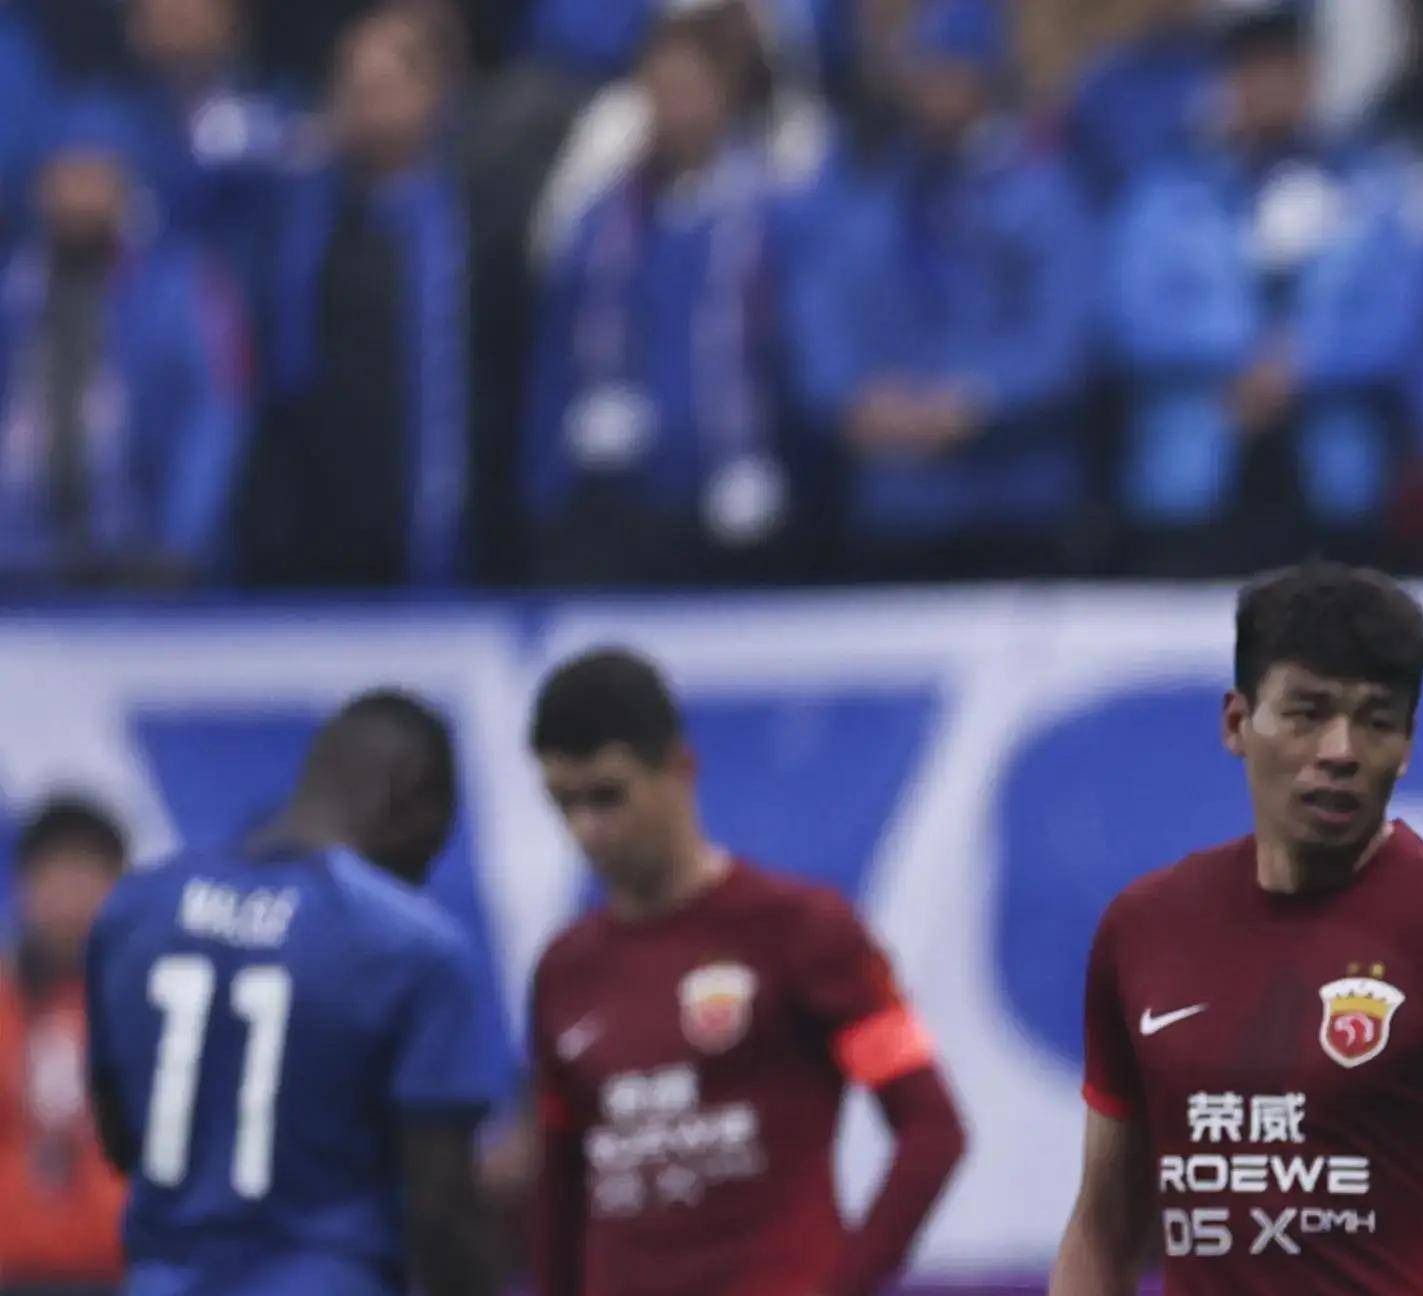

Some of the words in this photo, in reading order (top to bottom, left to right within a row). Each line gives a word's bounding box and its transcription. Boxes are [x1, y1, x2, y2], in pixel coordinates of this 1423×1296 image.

[143, 953, 293, 1200] 11
[1186, 1091, 1306, 1143] 荣威
[1159, 1153, 1371, 1195] ROEWE
